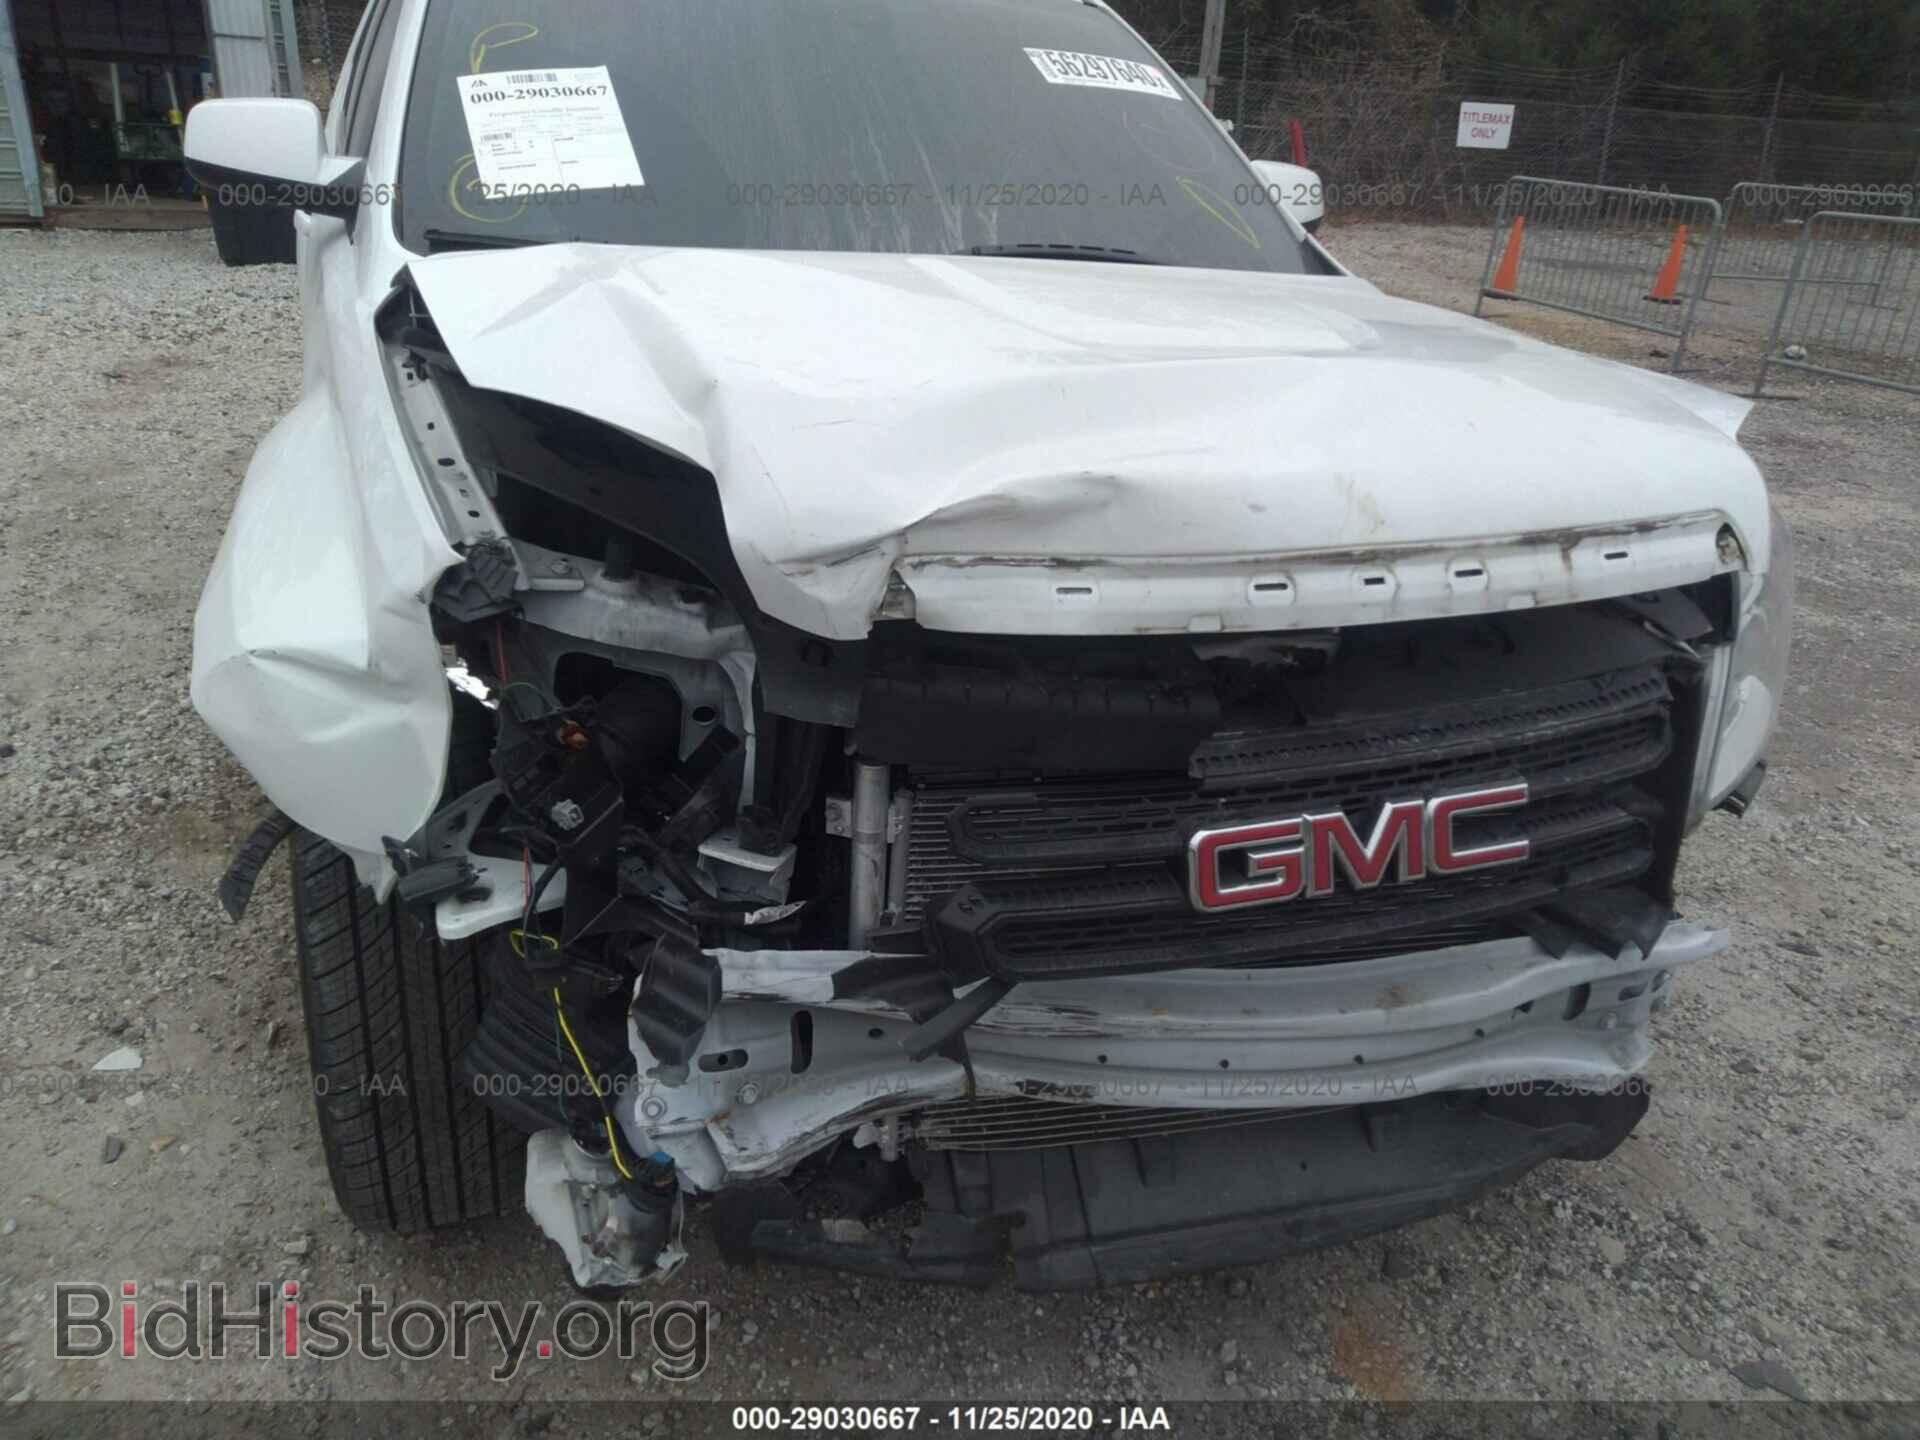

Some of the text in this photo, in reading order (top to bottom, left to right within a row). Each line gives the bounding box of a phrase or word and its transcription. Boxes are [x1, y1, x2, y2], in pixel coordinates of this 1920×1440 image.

[470, 85, 608, 104] 000-29030667
[1462, 111, 1511, 124] TITLEMAX
[1471, 127, 1497, 139] ONLY
[1189, 783, 1530, 912] GMC
